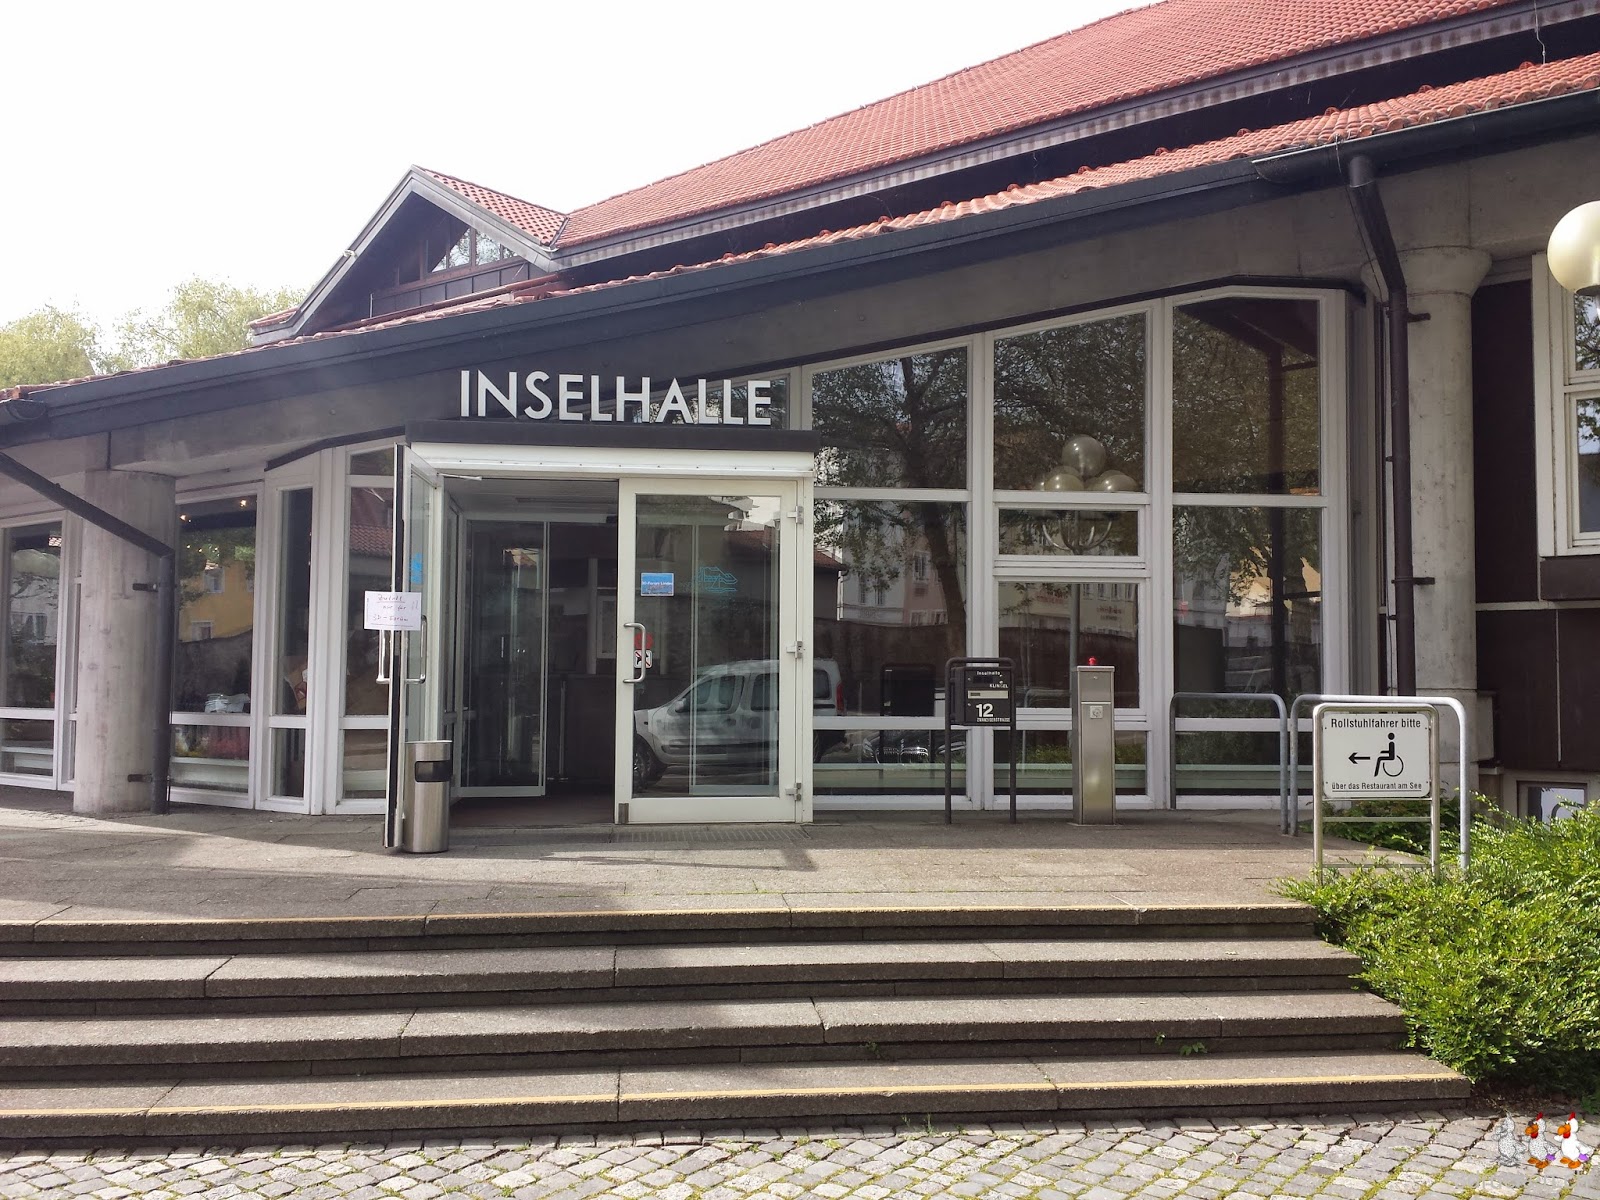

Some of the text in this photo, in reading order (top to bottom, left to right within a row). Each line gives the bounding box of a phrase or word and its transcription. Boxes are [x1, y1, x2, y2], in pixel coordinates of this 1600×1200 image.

[461, 370, 771, 425] INSELHALLE
[976, 703, 994, 717] 12
[1331, 718, 1421, 728] Rollstuhlfahrer bitte
[1331, 782, 1347, 790] über
[1348, 782, 1360, 790] das
[1361, 782, 1397, 790] Restaurant
